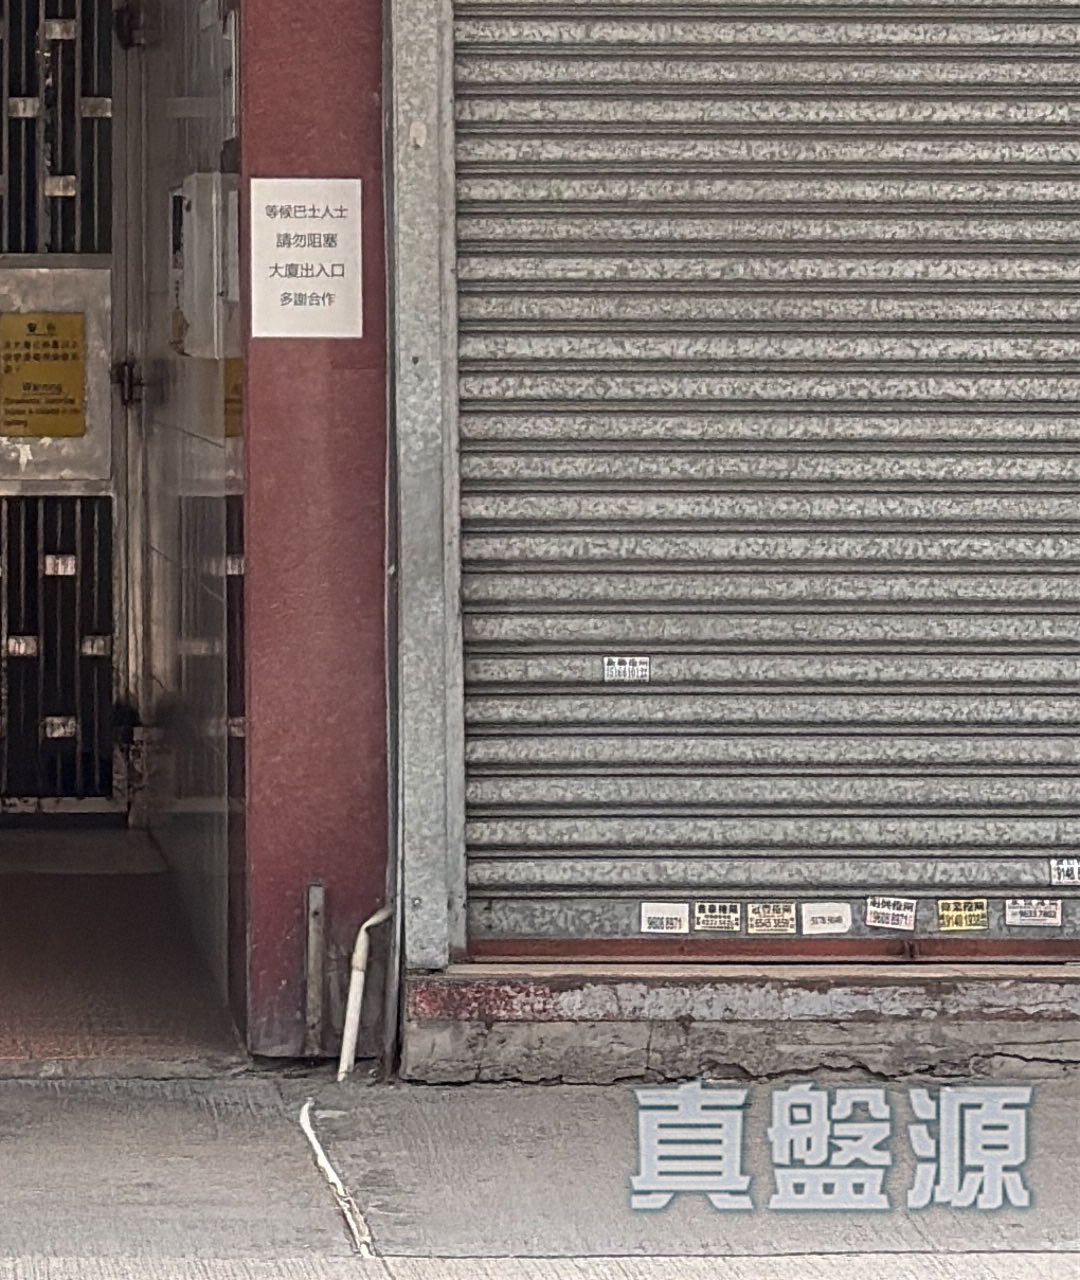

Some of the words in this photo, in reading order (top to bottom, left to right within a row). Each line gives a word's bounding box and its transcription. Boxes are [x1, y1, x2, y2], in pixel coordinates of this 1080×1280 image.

[264, 203, 349, 219] 等候巴士人士
[276, 232, 339, 249] 請勿阻塞
[268, 263, 345, 279] 大廈出入口
[279, 291, 336, 307] 多謝合作
